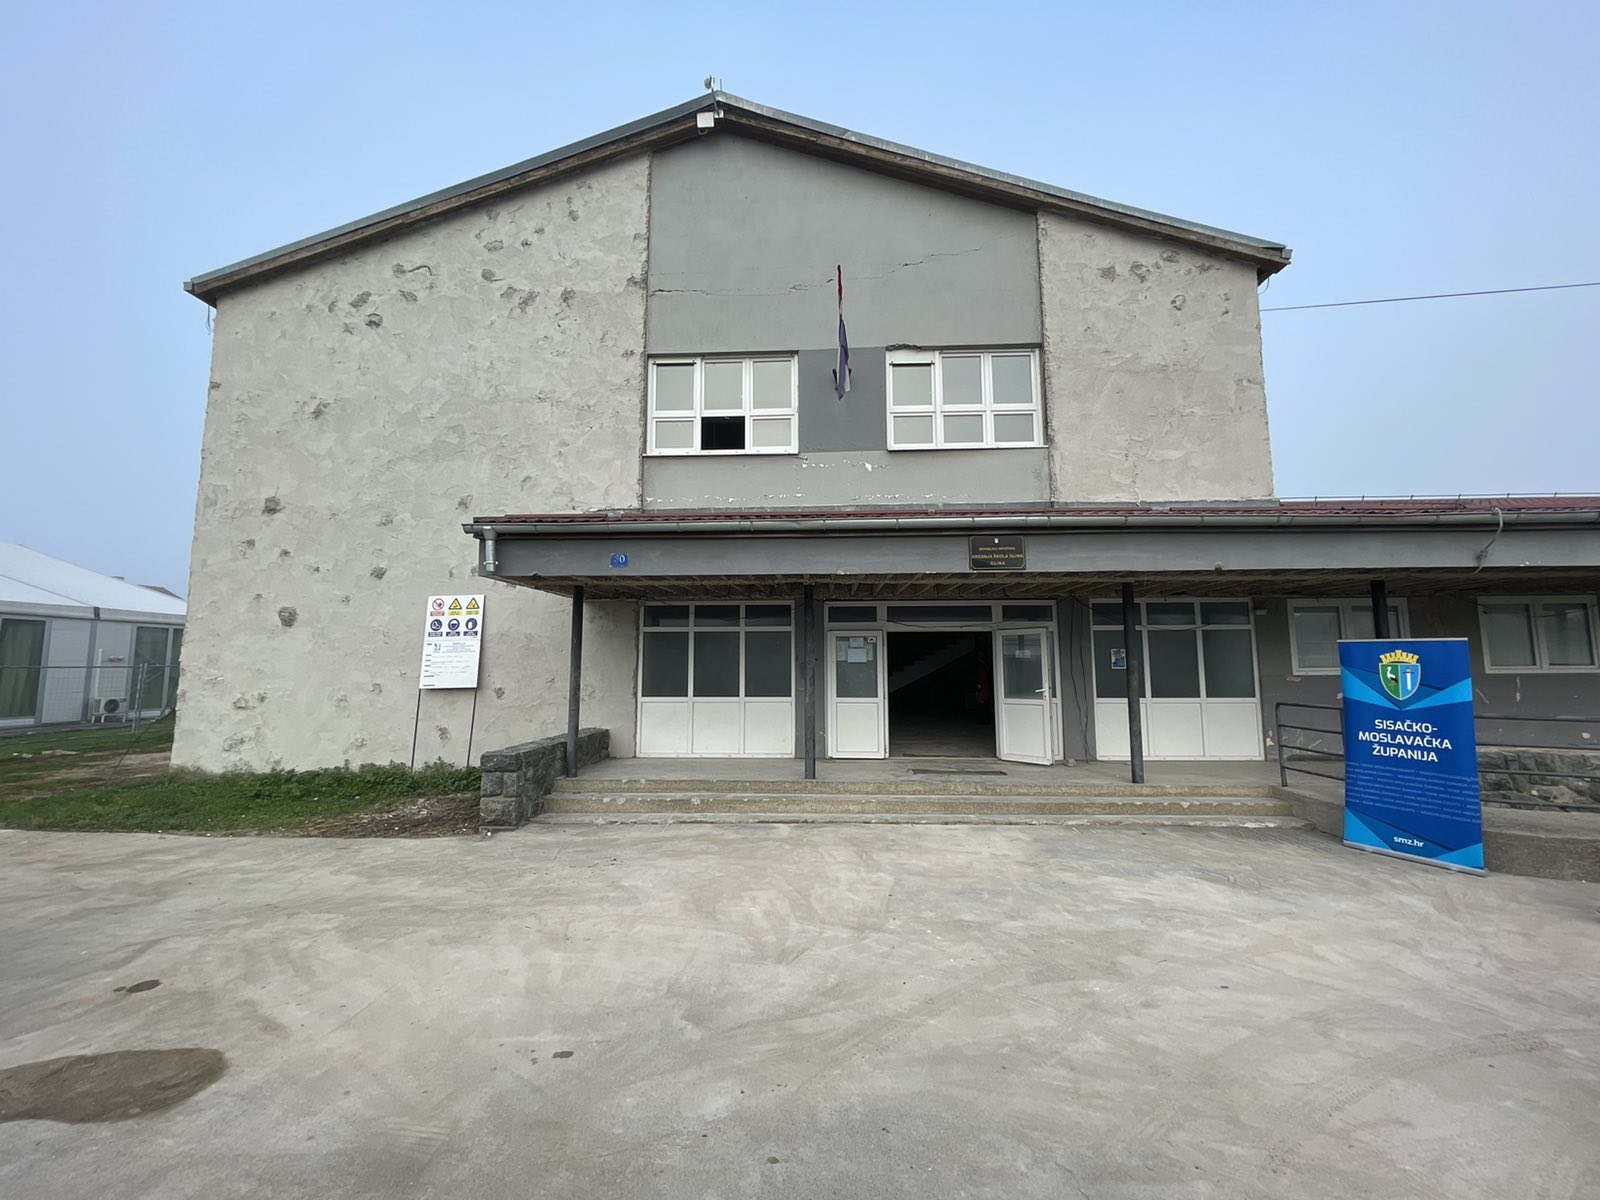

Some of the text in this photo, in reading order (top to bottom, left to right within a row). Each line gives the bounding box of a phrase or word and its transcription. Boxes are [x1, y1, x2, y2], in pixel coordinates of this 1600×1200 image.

[1374, 719, 1438, 734] SISAČKO-
[1358, 731, 1452, 750] MOSLAVAČKA
[1372, 743, 1438, 762] ŽUPANIJA
[1393, 836, 1424, 848] smz.hr
